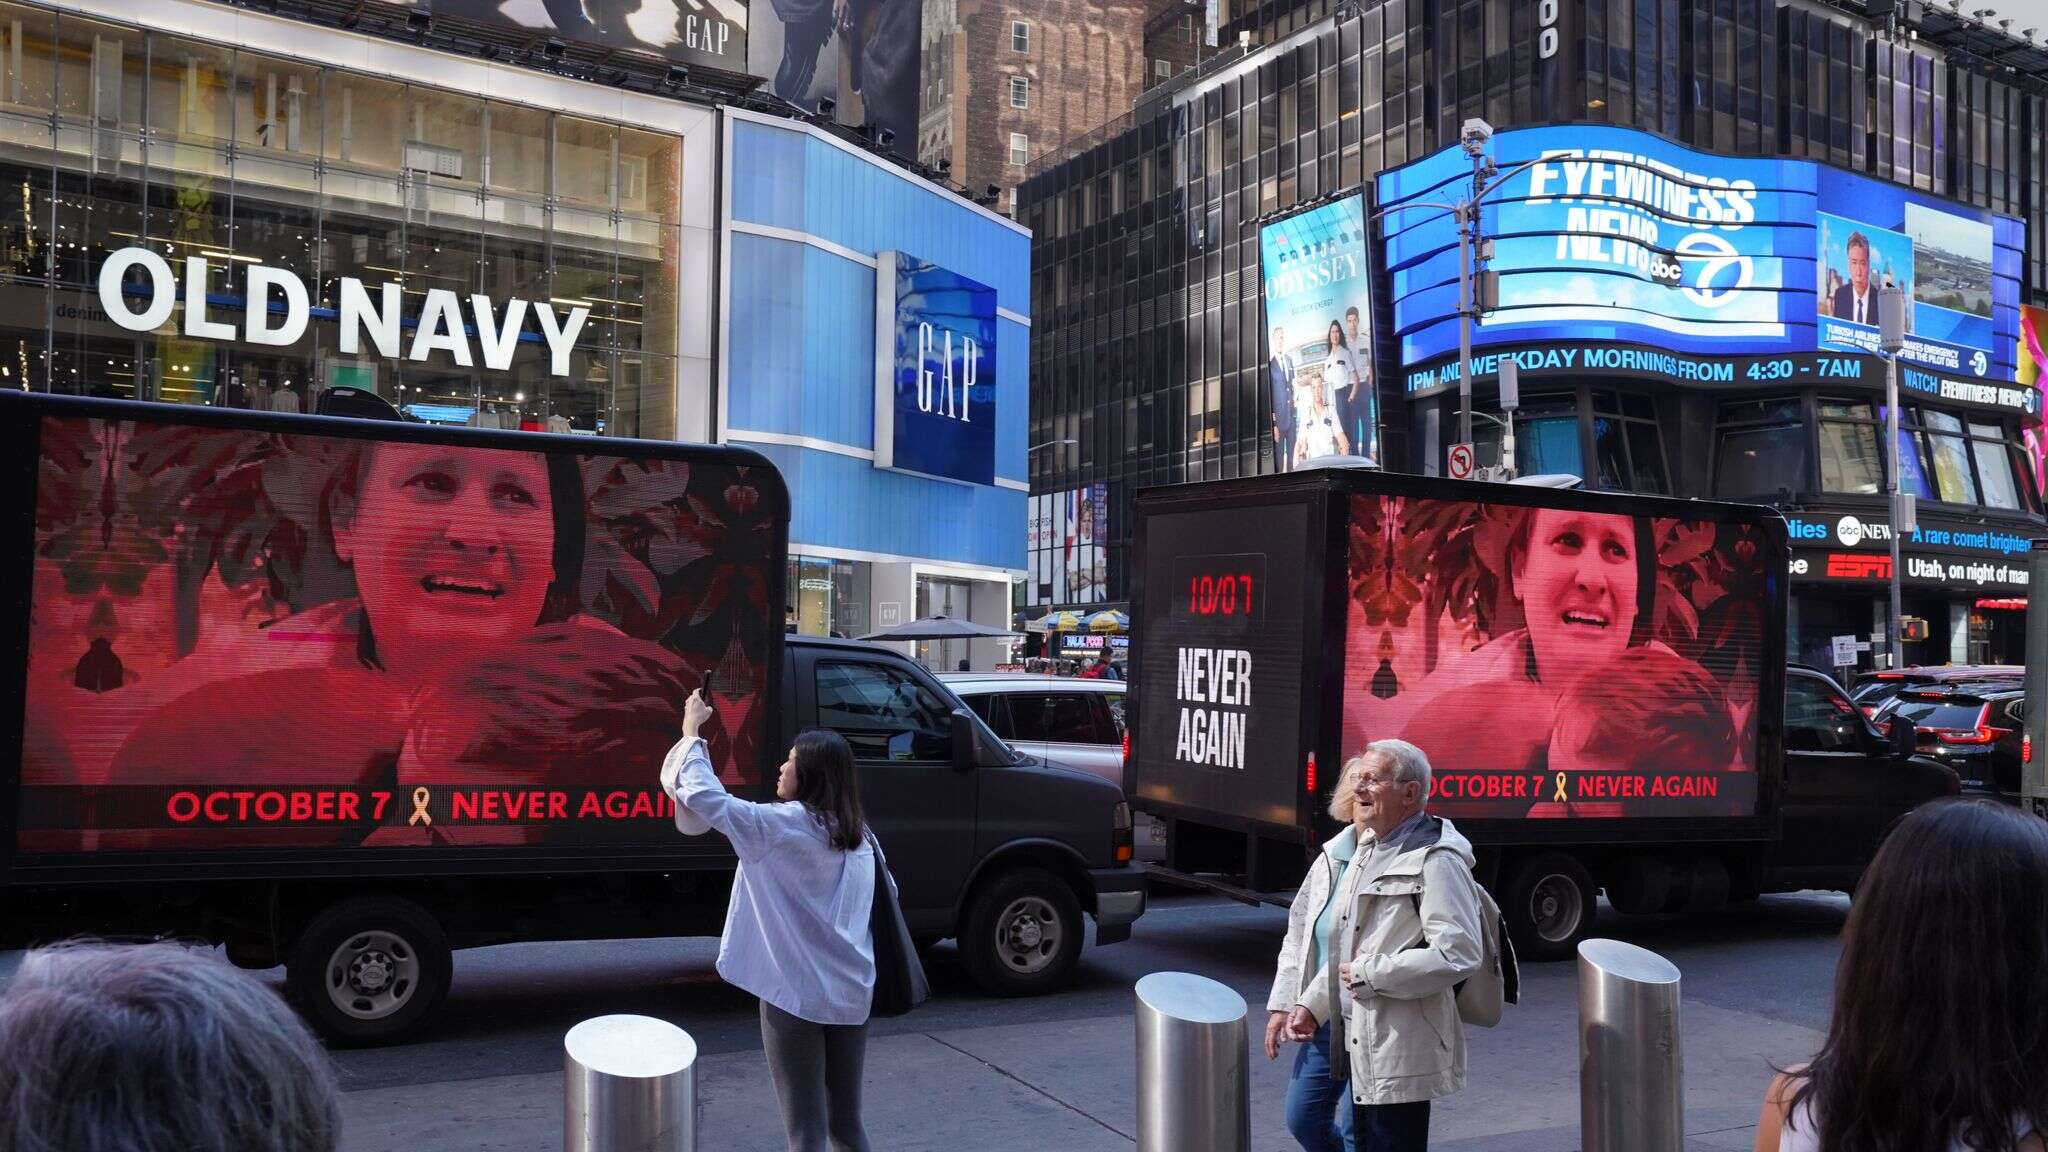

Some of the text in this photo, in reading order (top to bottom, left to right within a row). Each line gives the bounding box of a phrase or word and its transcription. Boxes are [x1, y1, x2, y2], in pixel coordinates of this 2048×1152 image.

[686, 14, 729, 55] GAP
[1525, 149, 1757, 232] EYEWITNESS
[1556, 207, 1659, 274] NEWS
[1265, 252, 1359, 302] ODYSSEY
[1650, 259, 1682, 280] abc
[98, 246, 591, 378] OLD NAVY
[917, 321, 977, 422] GAP
[1583, 349, 1677, 376] MORNINGS
[1678, 360, 1734, 382] FROM
[1746, 359, 1793, 380] 4:30
[1816, 358, 1861, 379] 7AM
[1904, 368, 1938, 394] WATCH
[1940, 379, 1998, 405] EYEWITNESS
[1998, 387, 2023, 409] NEWS
[1839, 523, 1900, 540] abc NEW
[1911, 523, 1923, 543] A
[1925, 529, 1950, 545] rare
[1953, 532, 1989, 549] comet
[1827, 553, 1893, 579] ESPN
[1907, 557, 1946, 582] Utah,
[1948, 564, 1965, 580] on
[1966, 562, 1996, 586] night
[1996, 565, 2008, 583] of
[1190, 575, 1254, 615] 10/07
[1176, 647, 1253, 707] NEVER
[1175, 707, 1247, 770] AGAIN
[1532, 775, 1546, 798] 7
[1577, 774, 1645, 798] NEVER
[1649, 775, 1718, 798] AGAIN
[167, 791, 360, 822] OCTOBER
[371, 791, 392, 820] 7
[452, 791, 569, 821] NEVER
